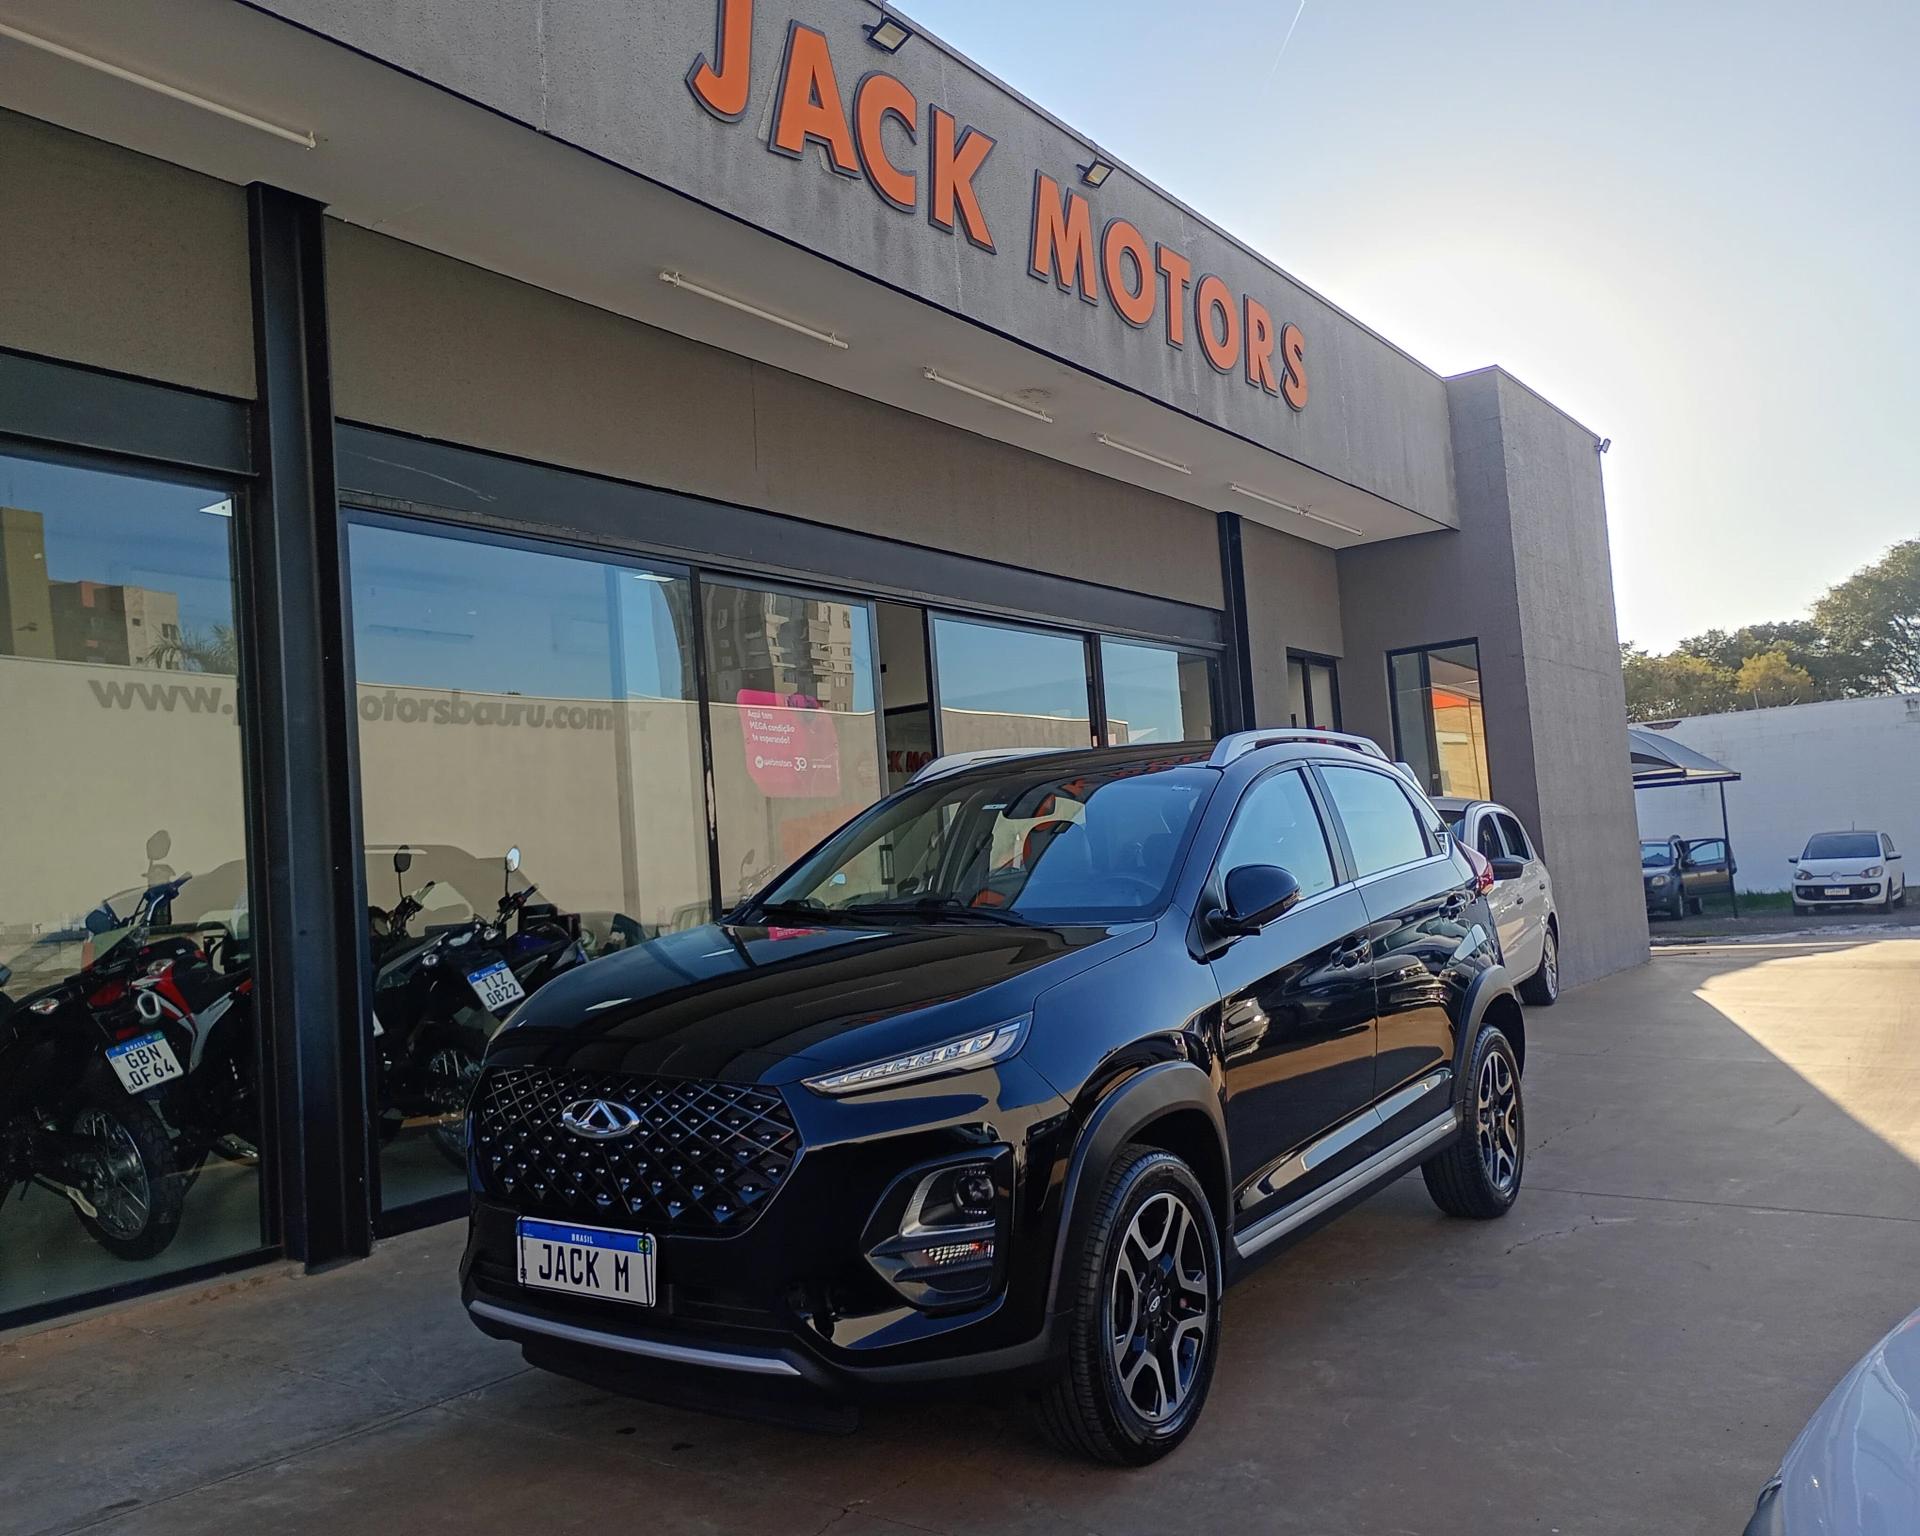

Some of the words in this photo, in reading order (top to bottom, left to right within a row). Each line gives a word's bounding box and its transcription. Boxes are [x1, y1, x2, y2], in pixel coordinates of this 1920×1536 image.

[686, 0, 997, 255] JACK
[1028, 169, 1308, 412] MOTORS
[749, 720, 768, 731] MEGA
[482, 972, 508, 991] TIZ
[125, 1040, 147, 1052] BRASIL
[125, 1044, 162, 1069] GBN
[571, 1233, 594, 1244] BRASIL
[538, 1243, 600, 1289] JACK
[614, 1253, 630, 1294] M
